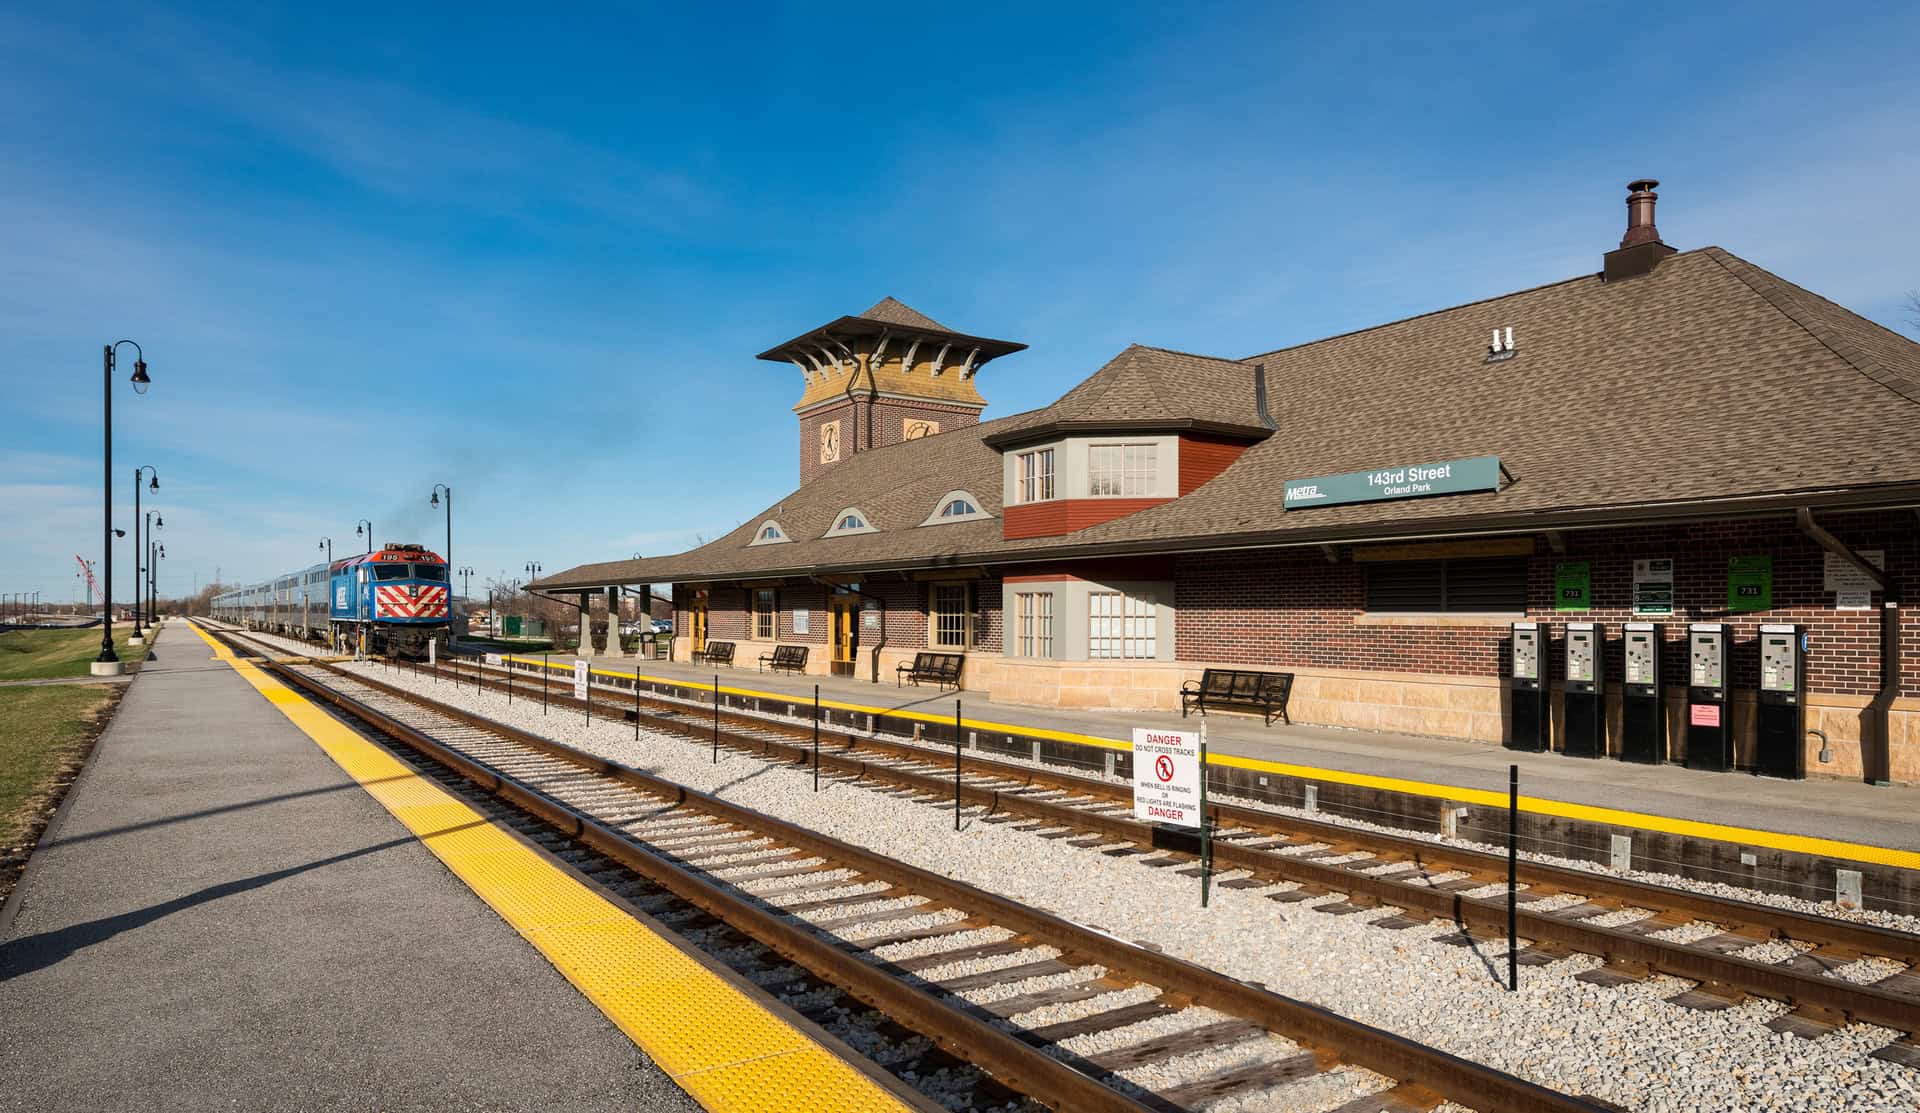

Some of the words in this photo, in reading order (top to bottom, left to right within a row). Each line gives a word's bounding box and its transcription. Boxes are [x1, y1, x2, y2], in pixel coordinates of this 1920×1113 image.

[1367, 469, 1405, 487] 143rd
[1408, 463, 1451, 482] Street
[1286, 484, 1320, 501] Metra
[1383, 484, 1411, 496] Orland
[1412, 482, 1432, 493] Park
[1147, 734, 1182, 746] DANGER
[1143, 745, 1154, 753] NOT
[1154, 746, 1173, 755] CROSS
[1173, 747, 1195, 757] TRACKS
[1154, 783, 1166, 791] BELL
[1172, 785, 1192, 794] RINGING
[1145, 797, 1162, 806] LIGHTS
[1173, 801, 1196, 811] FLASHING
[1148, 806, 1183, 820] DANGER
